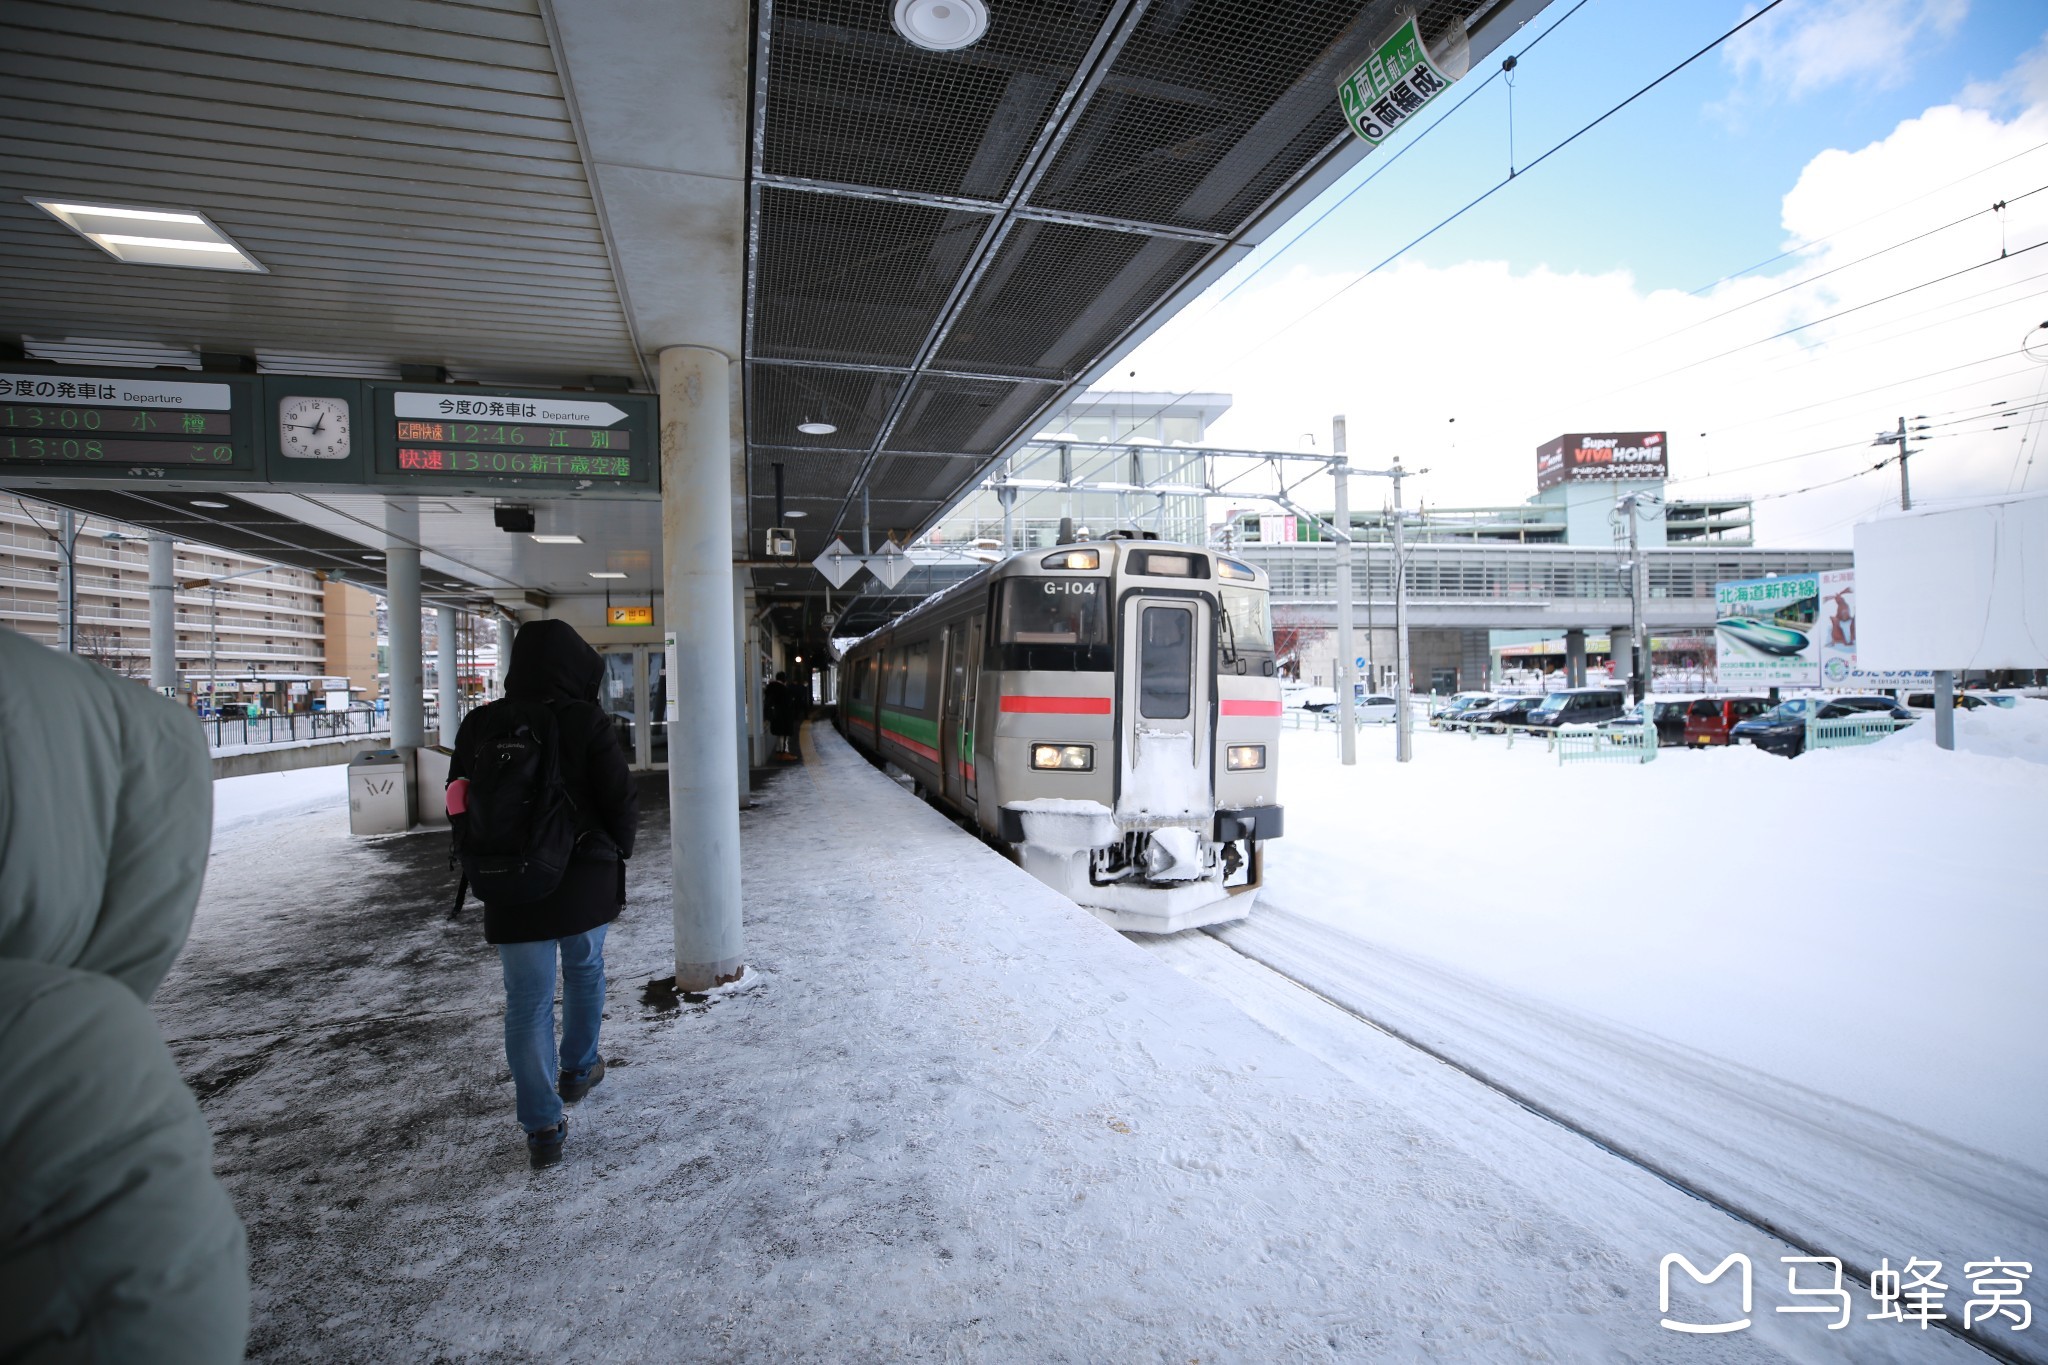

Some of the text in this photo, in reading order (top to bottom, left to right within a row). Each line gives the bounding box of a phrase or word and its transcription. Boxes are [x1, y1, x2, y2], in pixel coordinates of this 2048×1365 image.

[1359, 63, 1444, 138] 6両編成
[0, 379, 182, 404] 今度の発車は Departure
[5, 407, 102, 431] 13:00
[438, 399, 590, 422] 今度の発車は Departure
[398, 422, 443, 441] 区間快速
[448, 424, 525, 445] 12:46
[1583, 437, 1618, 450] Super
[7, 436, 233, 462] 13:08 この
[399, 449, 630, 477] 快速 13:06 新千歳空港
[1044, 581, 1096, 595] G-104
[1719, 579, 1817, 604] 北海道新幹線
